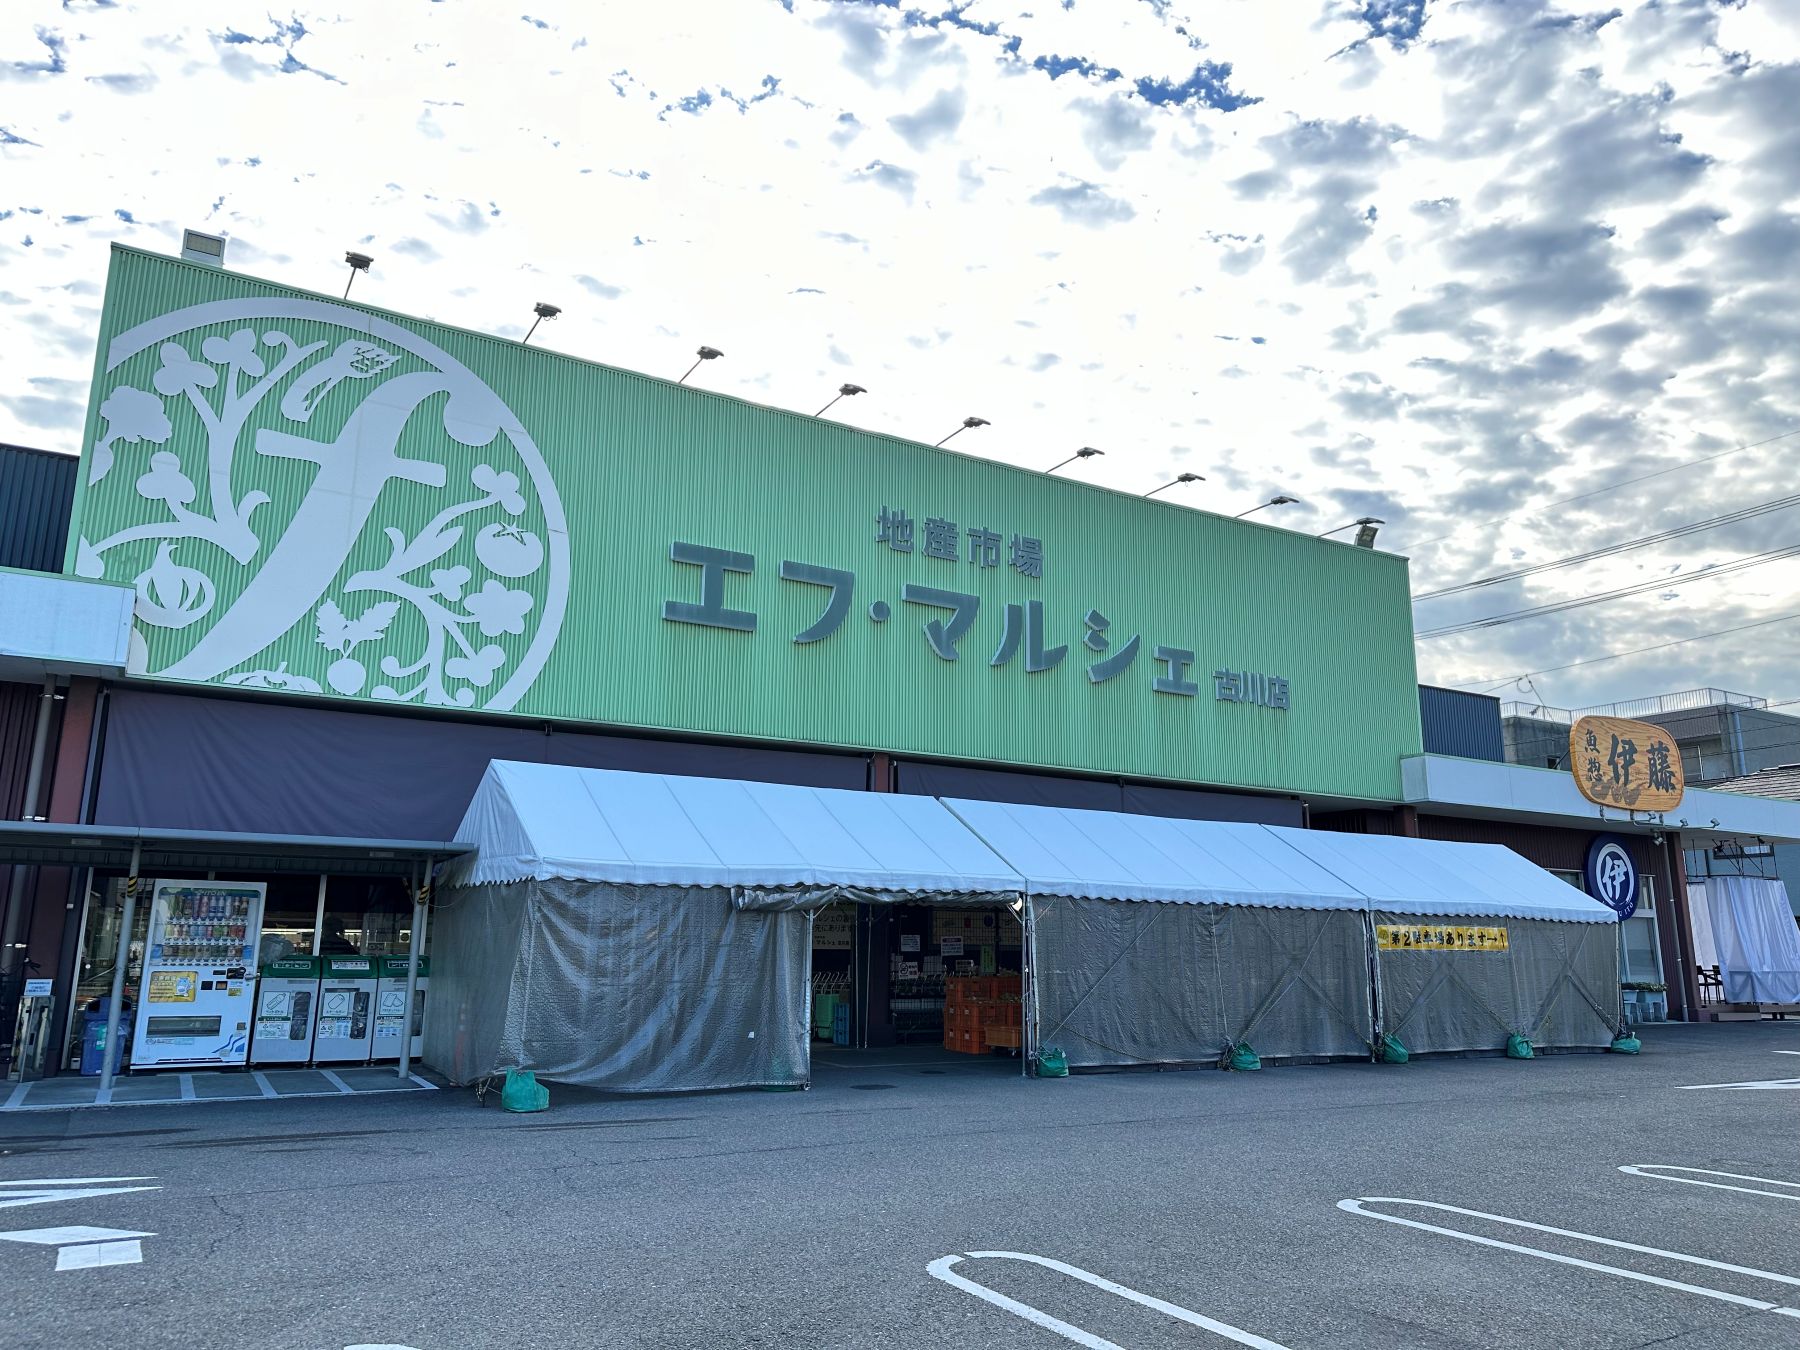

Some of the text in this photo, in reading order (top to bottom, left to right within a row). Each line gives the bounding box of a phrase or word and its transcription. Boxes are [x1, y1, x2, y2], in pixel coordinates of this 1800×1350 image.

[875, 505, 1043, 578] 地産市場
[662, 540, 1289, 709] エフ・マルシェ 古川店
[1608, 733, 1677, 794] 伊藤
[1602, 854, 1628, 901] 伊
